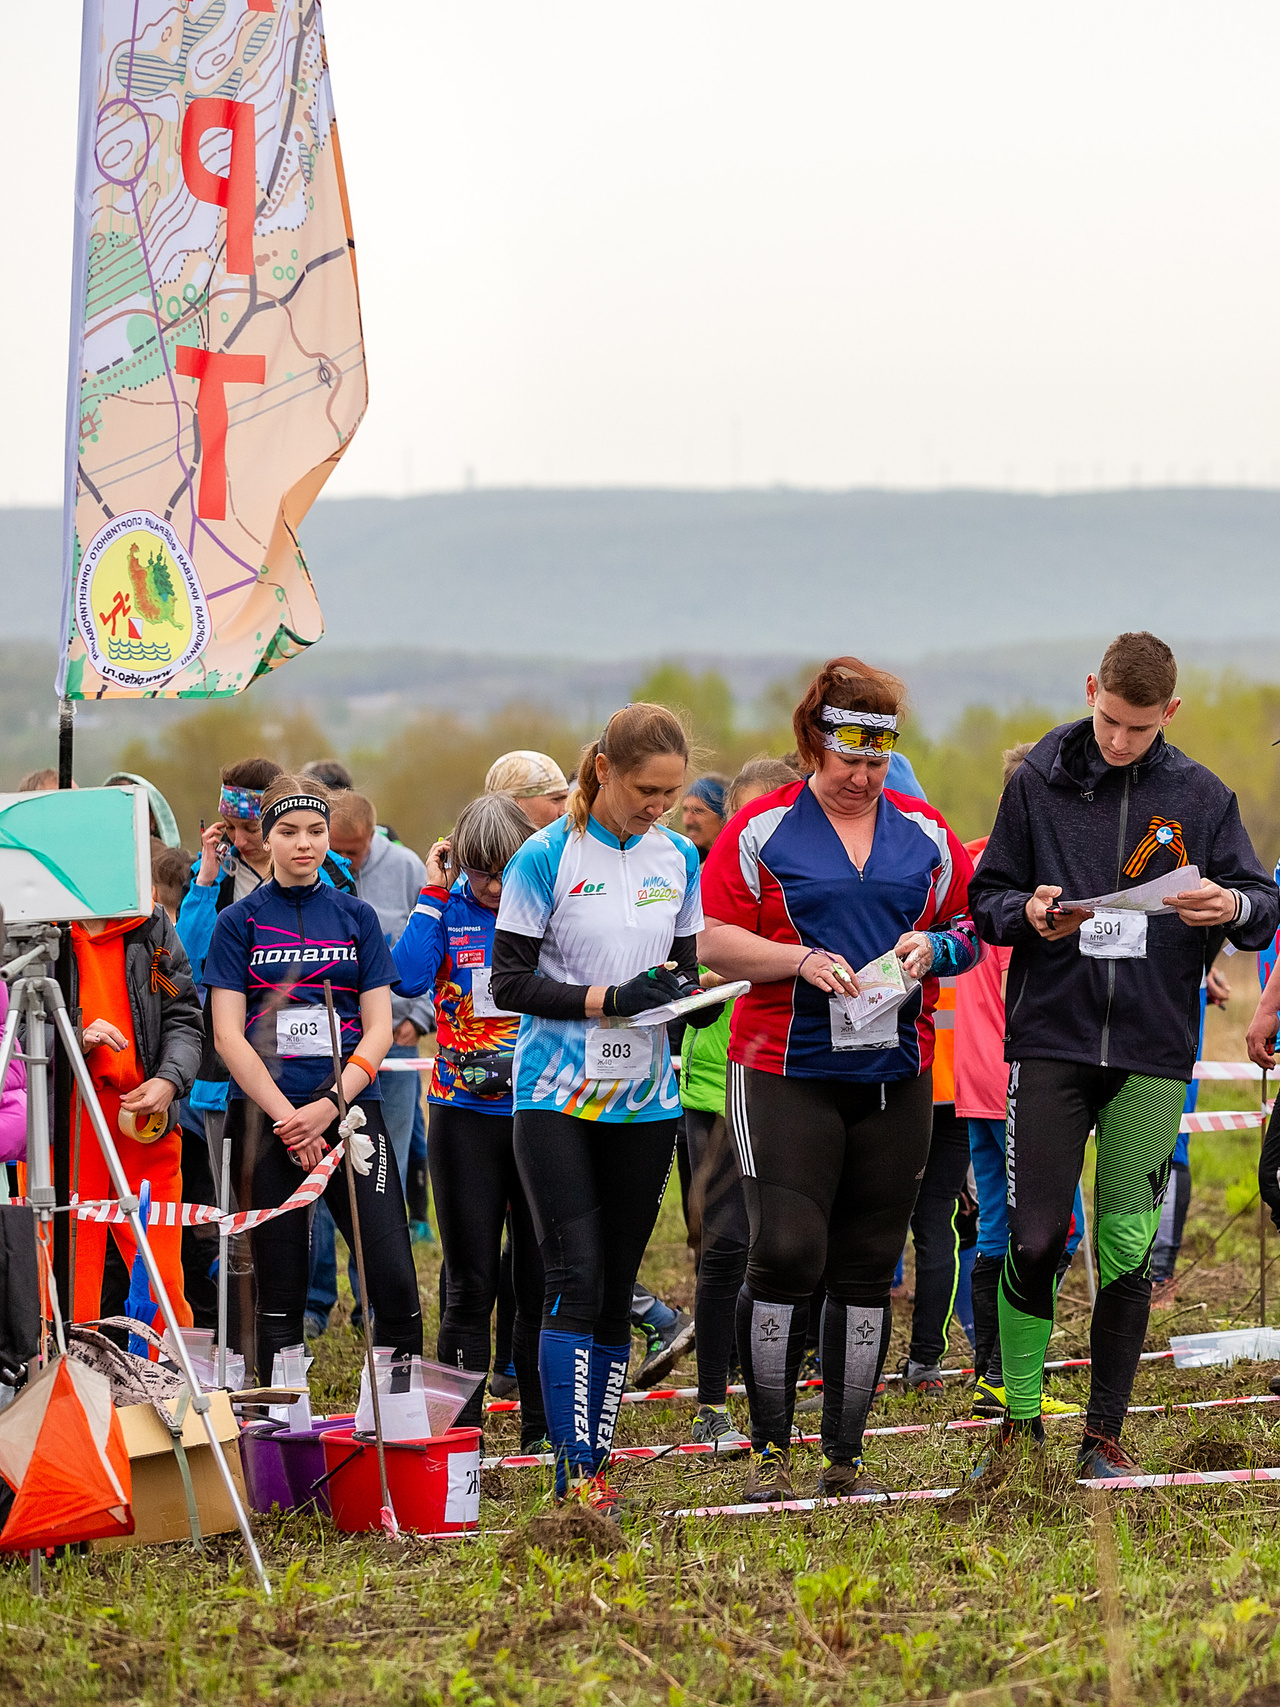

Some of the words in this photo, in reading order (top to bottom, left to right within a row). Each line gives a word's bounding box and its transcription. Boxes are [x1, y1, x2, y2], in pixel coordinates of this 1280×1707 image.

[274, 798, 326, 816] noname
[643, 876, 672, 888] WMOC
[648, 887, 671, 898] 2020
[1093, 921, 1121, 936] 501
[250, 946, 358, 966] noname
[289, 1022, 318, 1036] 603
[602, 1043, 632, 1059] 803
[597, 1058, 612, 1066] Ж40
[1006, 1098, 1017, 1209] VENUM
[375, 1133, 388, 1195] noname
[574, 1348, 591, 1447] TRIMTEX
[596, 1361, 627, 1452] TRIMTEX
